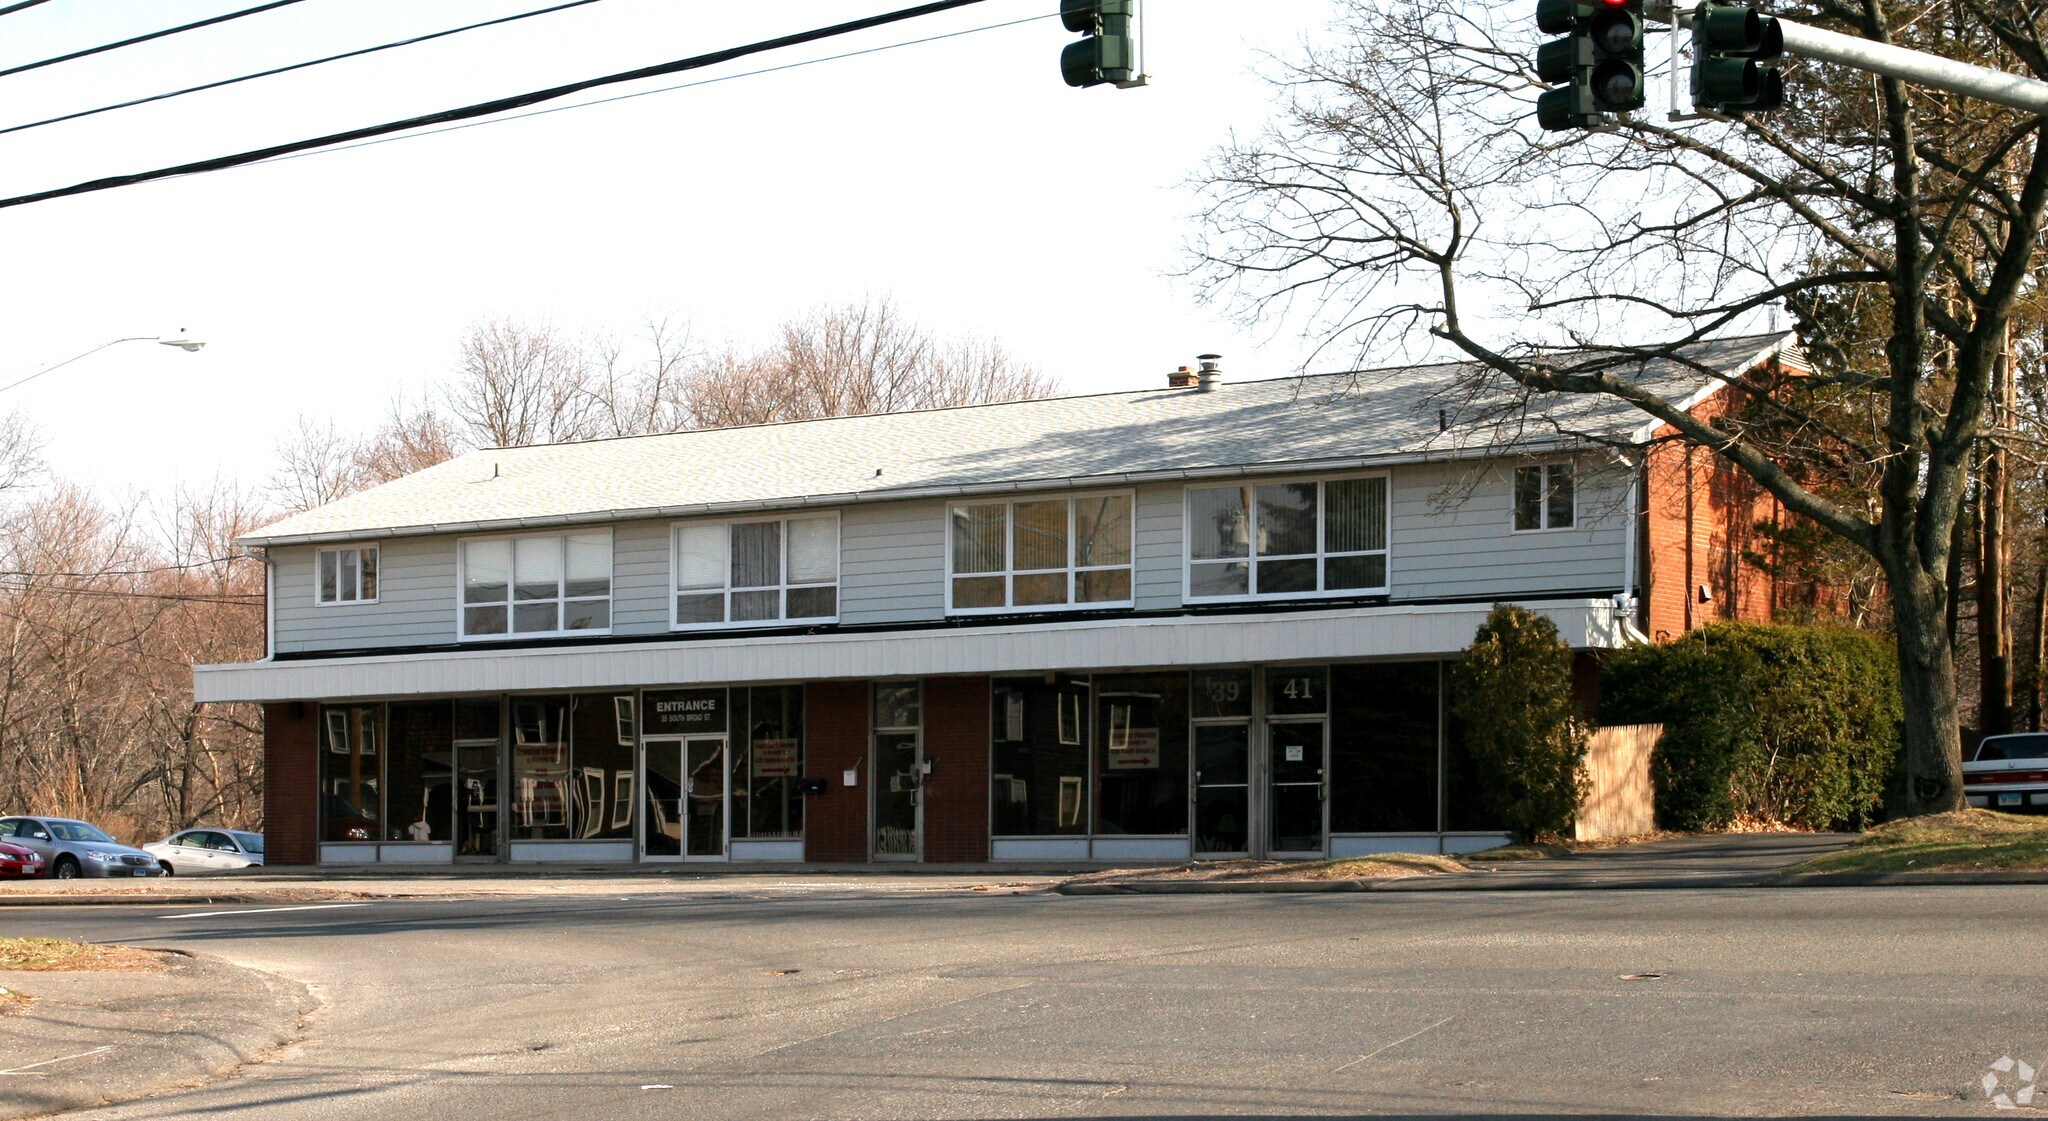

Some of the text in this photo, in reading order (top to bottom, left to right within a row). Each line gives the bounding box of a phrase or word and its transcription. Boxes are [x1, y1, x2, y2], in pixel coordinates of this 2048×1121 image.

[1212, 680, 1240, 702] 39
[1283, 678, 1313, 699] 41
[656, 700, 716, 712] ENTRANCE
[669, 714, 685, 722] SOUTH
[686, 713, 703, 722] BROAD
